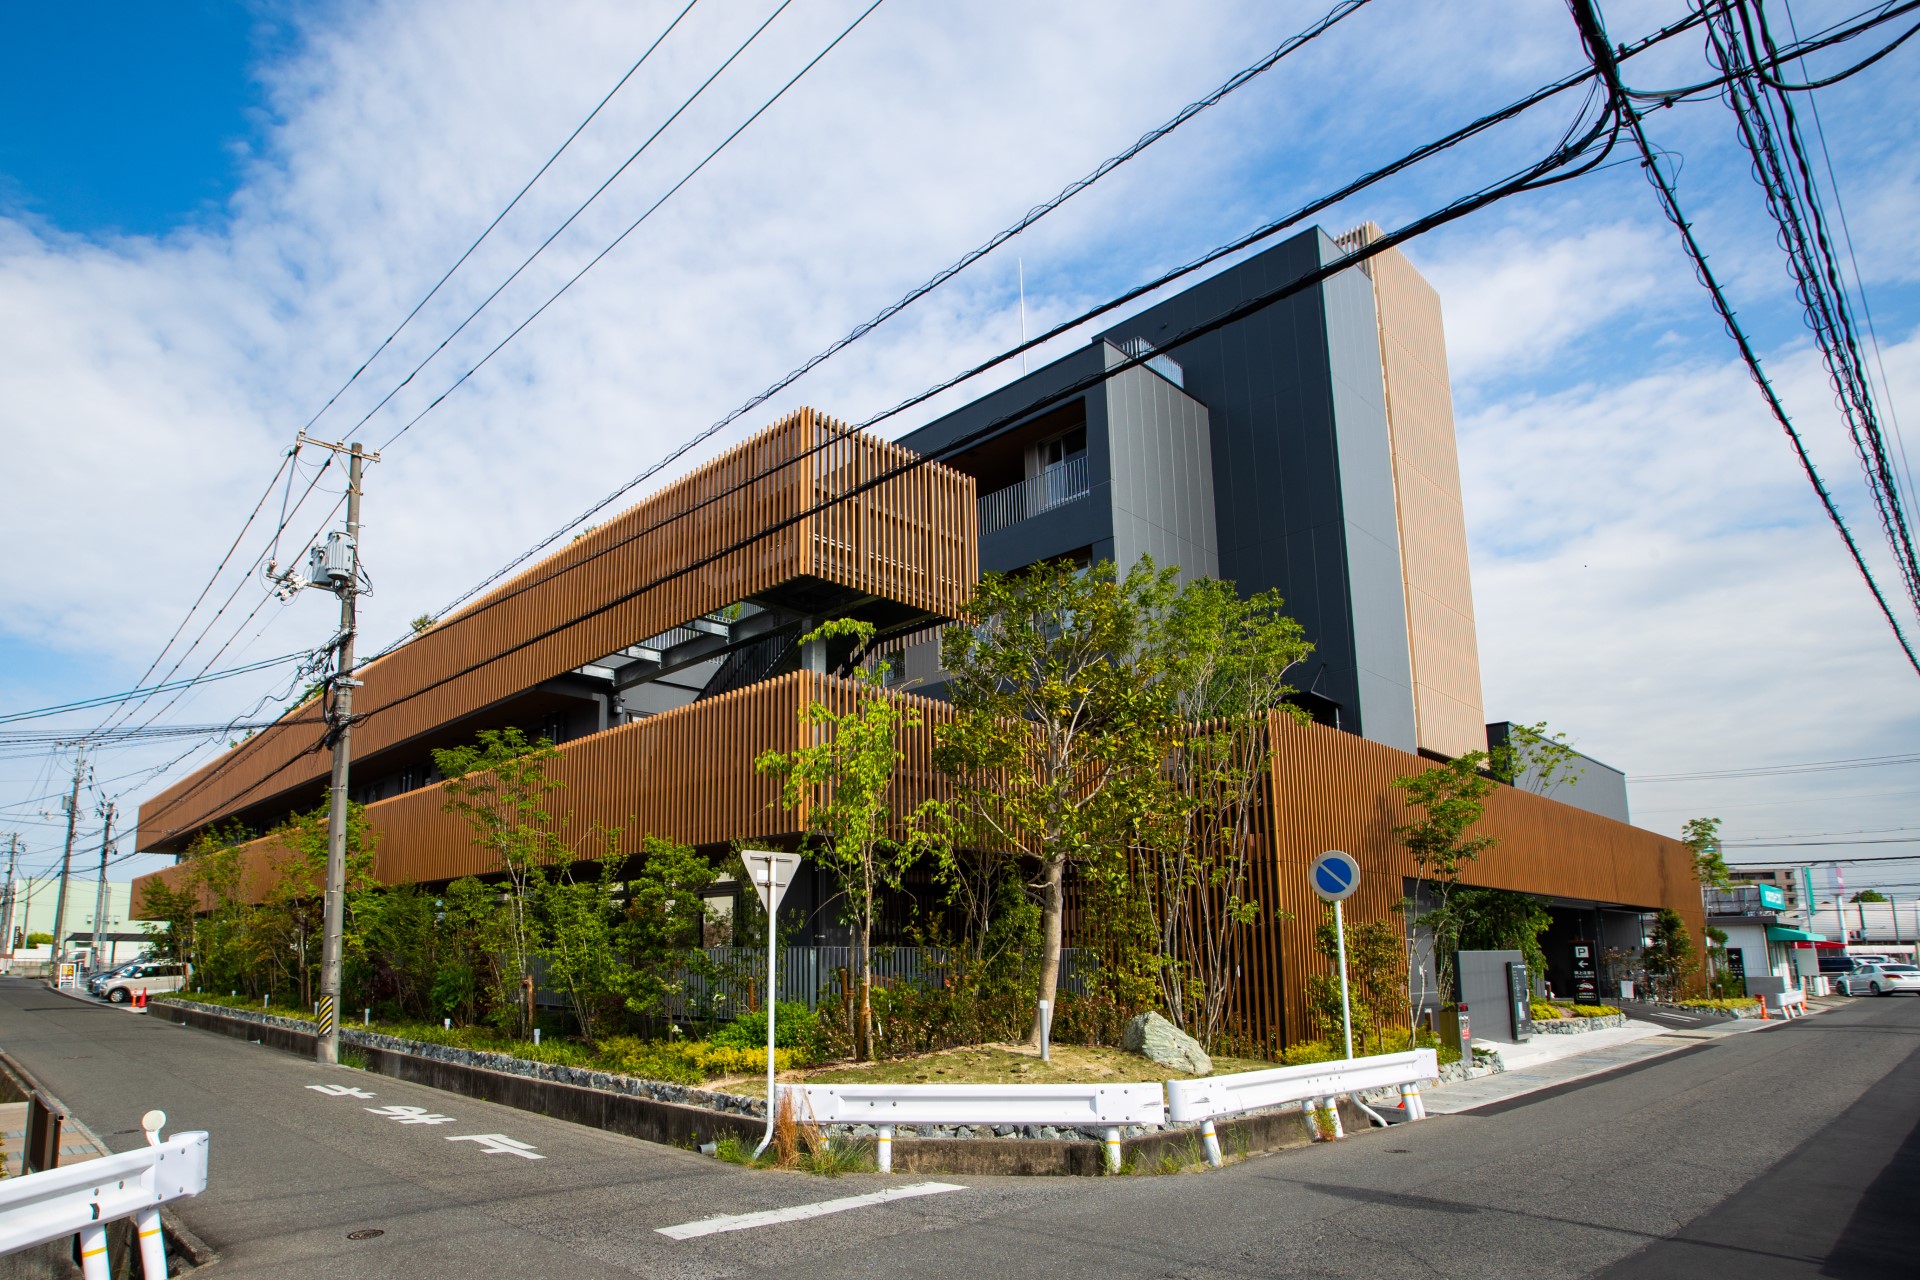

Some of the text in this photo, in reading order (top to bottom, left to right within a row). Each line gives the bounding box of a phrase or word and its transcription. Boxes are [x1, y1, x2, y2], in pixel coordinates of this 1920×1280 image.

[1577, 947, 1587, 957] P
[304, 1084, 547, 1160] 止まれ
